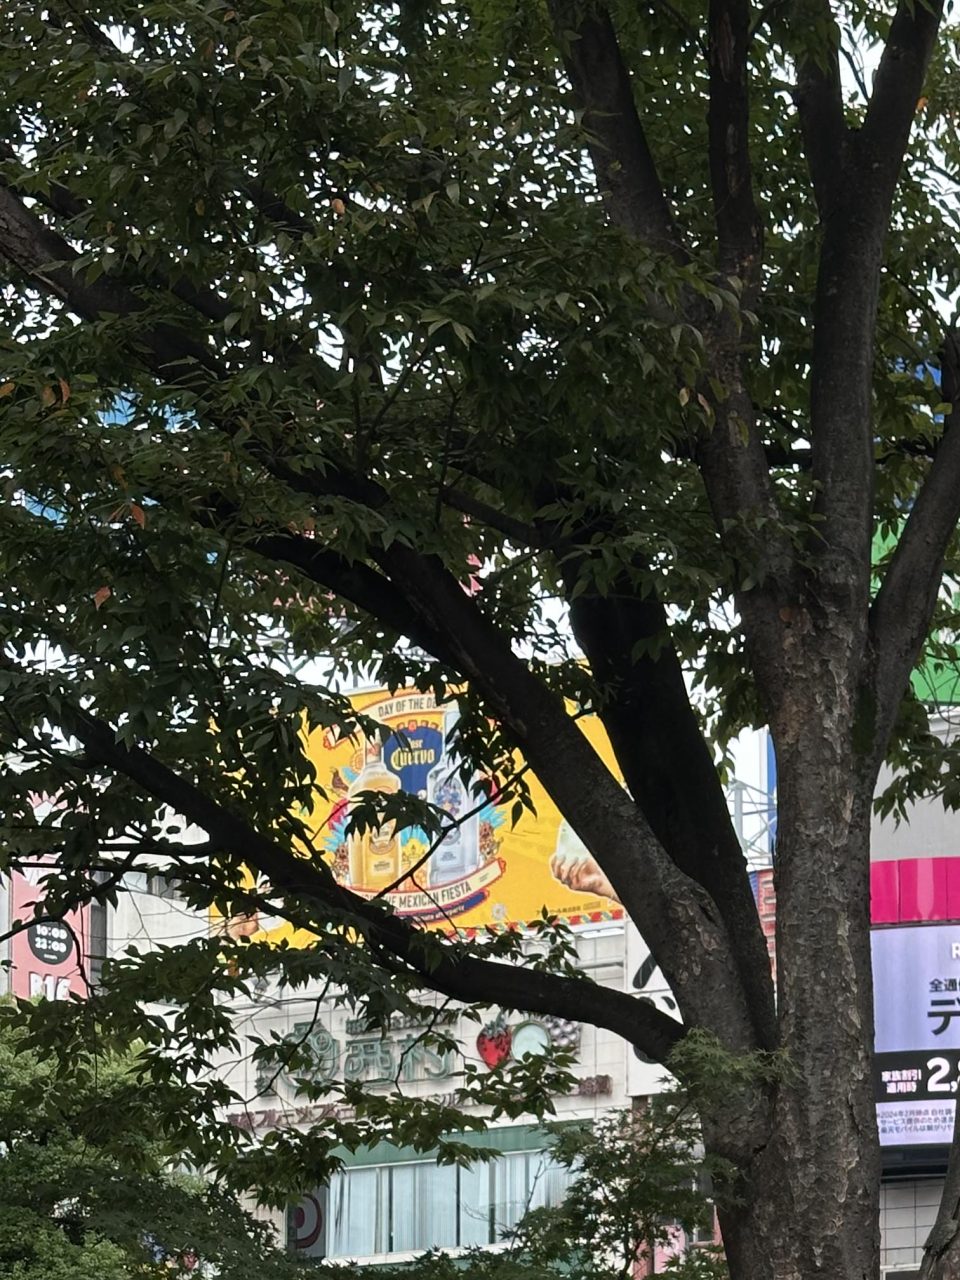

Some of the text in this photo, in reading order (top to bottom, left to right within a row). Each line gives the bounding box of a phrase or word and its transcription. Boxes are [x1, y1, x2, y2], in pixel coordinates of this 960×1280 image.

[378, 703, 393, 717] DAY
[396, 700, 407, 712] OF
[408, 698, 423, 709] THE
[390, 748, 435, 770] Cuervo
[398, 889, 440, 907] MEXICAN
[441, 881, 472, 902] FIESTA
[36, 925, 67, 939] 10:00
